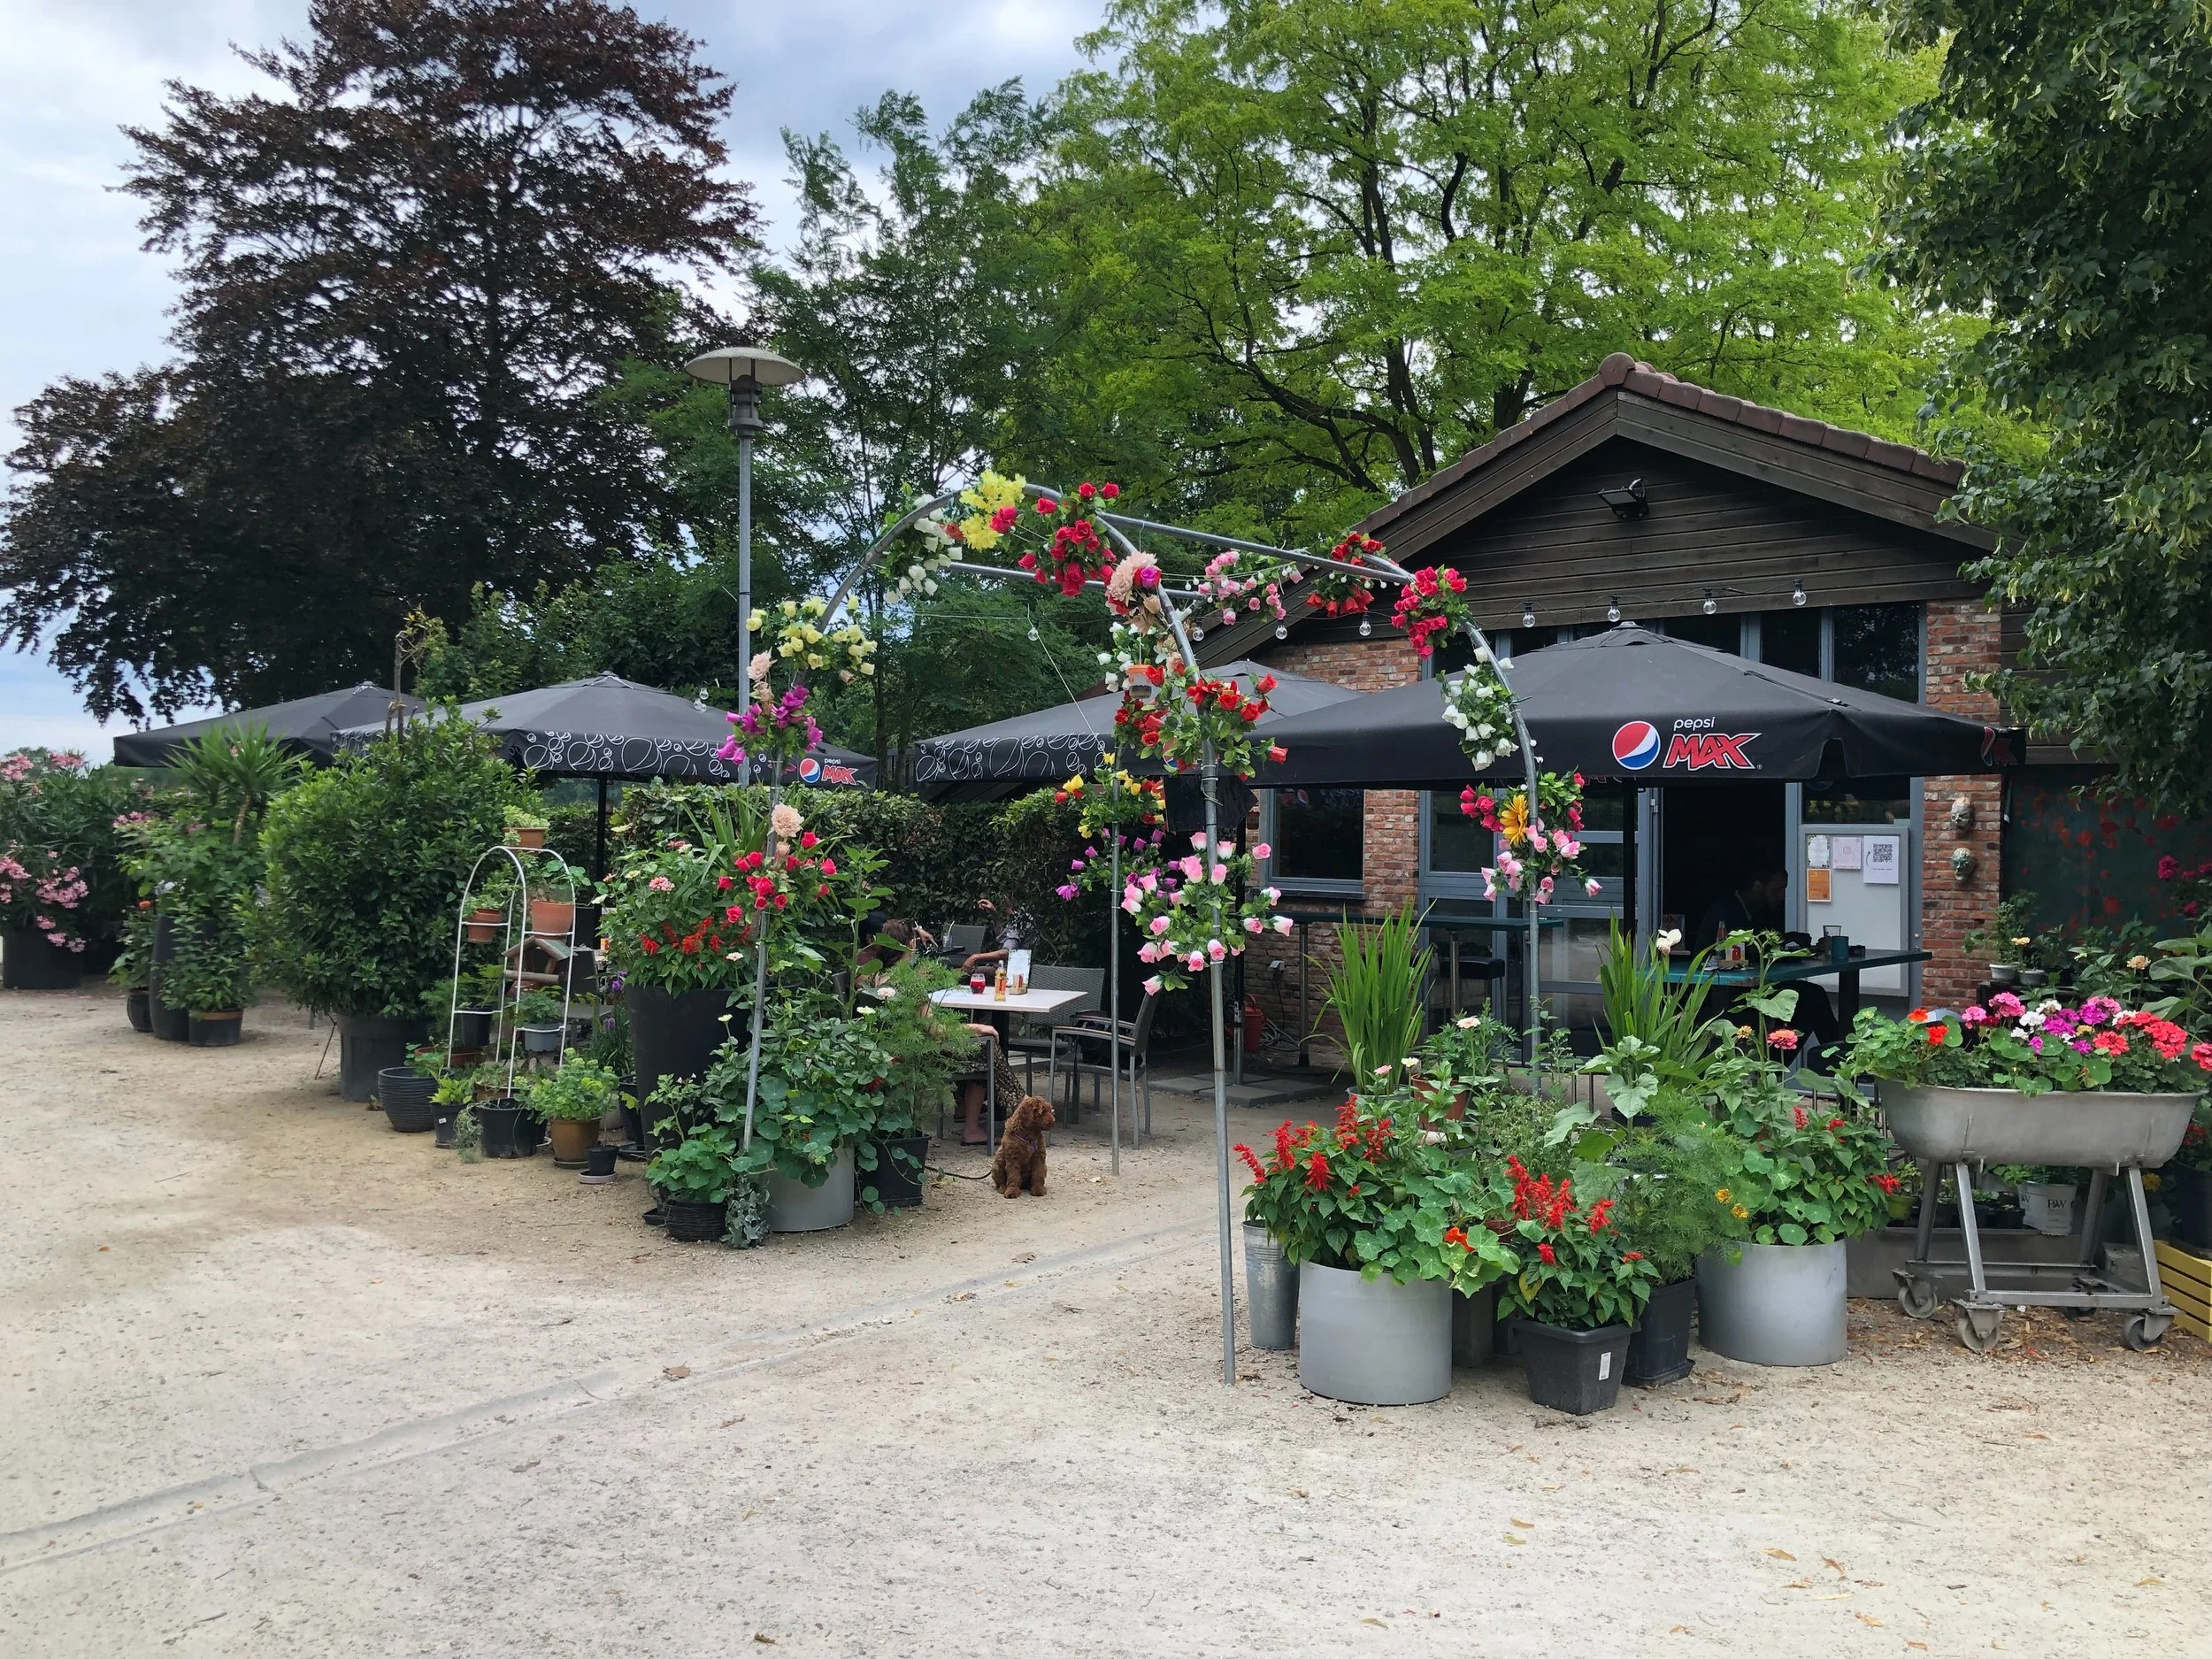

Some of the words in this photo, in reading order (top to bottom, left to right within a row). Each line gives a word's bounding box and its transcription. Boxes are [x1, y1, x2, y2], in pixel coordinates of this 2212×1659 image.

[1673, 716, 1716, 732] pepsi
[1663, 733, 1763, 771] MAX
[821, 764, 859, 786] MAX
